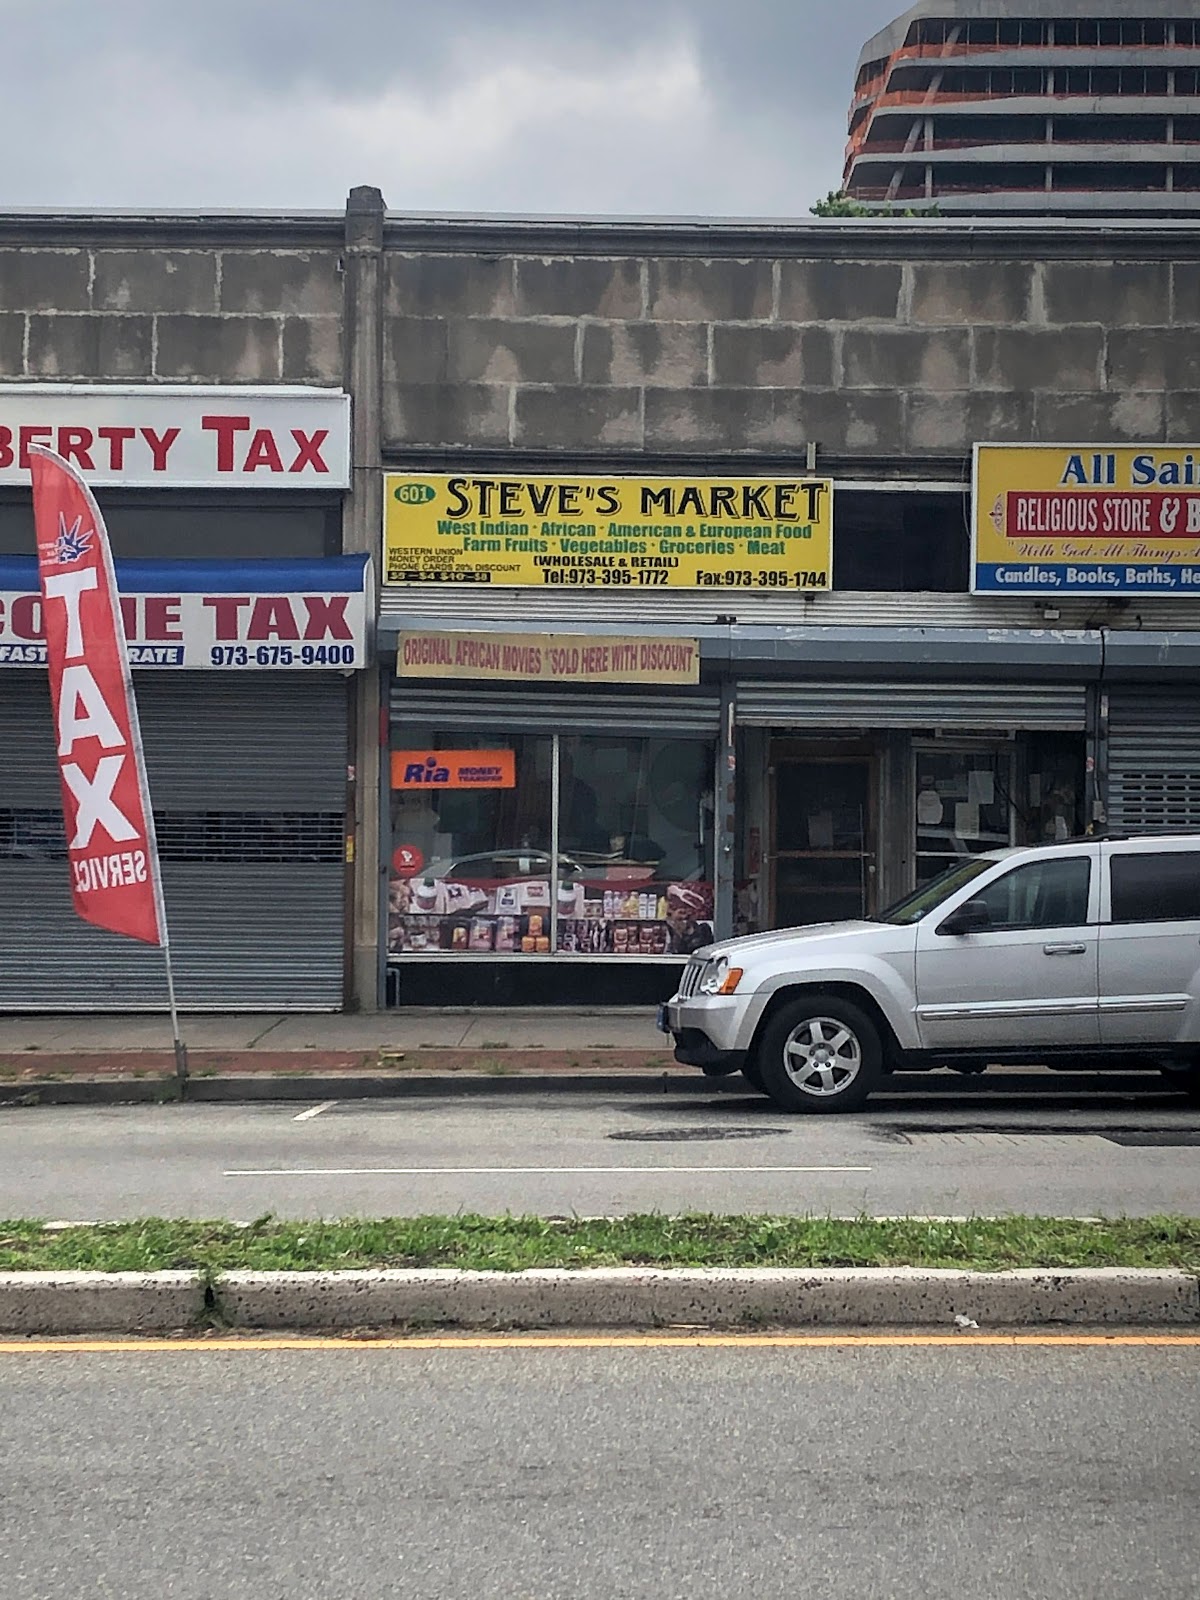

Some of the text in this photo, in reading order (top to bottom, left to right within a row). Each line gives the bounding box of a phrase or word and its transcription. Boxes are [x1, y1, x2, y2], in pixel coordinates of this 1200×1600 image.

[1061, 454, 1200, 485] All Sai
[399, 486, 429, 502] 601
[446, 478, 828, 524] STEVE'S MARKET
[1017, 498, 1098, 532] RELIGIOUS
[1103, 498, 1151, 532] STORE
[1159, 497, 1180, 533] &
[437, 520, 812, 540] West Indian African American & European Food
[388, 547, 463, 556] WESTERN UNION
[463, 537, 786, 555] Farm Fruits Vegetables Groceries Meat
[389, 563, 419, 572] PHONE
[421, 563, 453, 572] CARDS
[475, 564, 521, 573] DISCOUNT
[423, 556, 455, 564] ORDER
[533, 556, 679, 568] (WHOLESALE & RETAIL)
[543, 569, 669, 585] Tel:973-395-1772
[697, 570, 827, 587] Fax:973-395-1744
[995, 567, 1061, 586] Candles,
[1066, 567, 1120, 586] Books,
[1126, 566, 1176, 587] Baths,
[203, 597, 354, 640] TAX
[211, 645, 355, 666] 973-675-9400
[403, 637, 453, 666] ORIGINAL
[455, 640, 501, 669] AFRICAN
[503, 645, 543, 675] MOVIES
[581, 645, 609, 673] HERE
[611, 644, 637, 672] WITH
[640, 643, 694, 673] DISCOUNT
[403, 756, 450, 783] Ria
